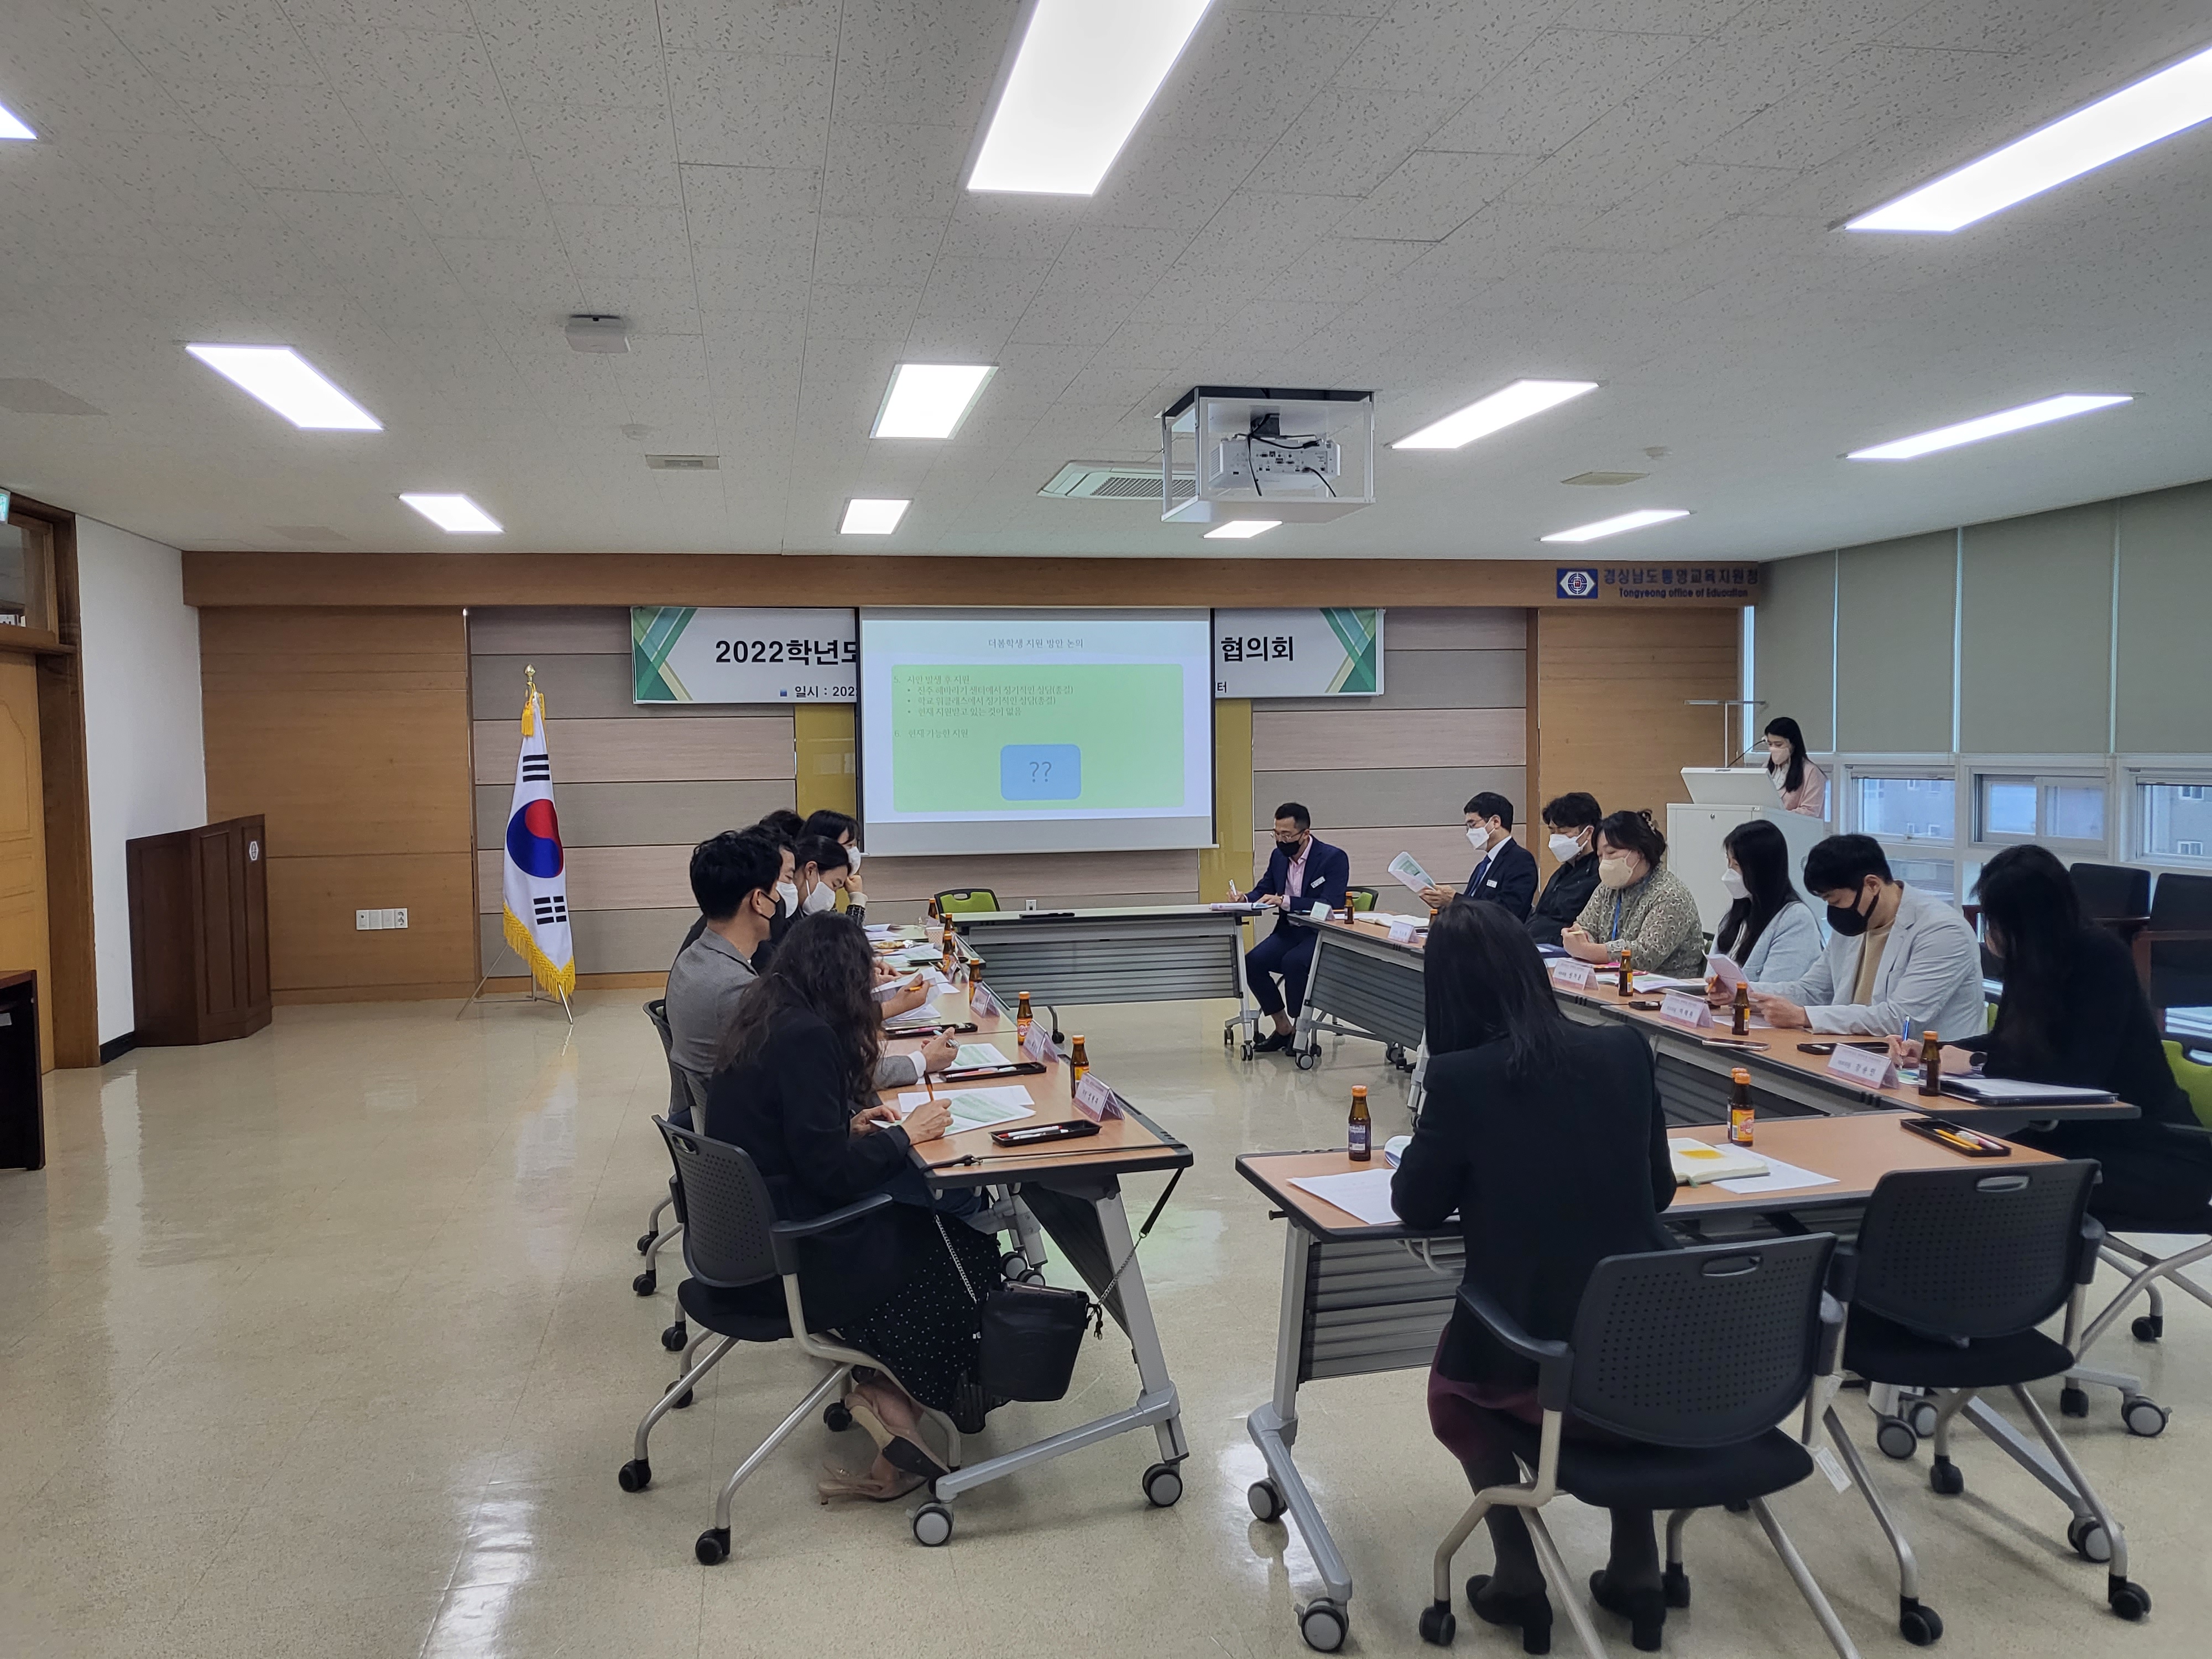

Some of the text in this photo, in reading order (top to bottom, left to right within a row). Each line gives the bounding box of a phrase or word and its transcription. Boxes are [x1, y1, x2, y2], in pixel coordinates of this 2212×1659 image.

[1619, 588, 1666, 598] Tongyeong
[1695, 588, 1704, 598] of
[1706, 588, 1748, 598] Education
[1026, 638, 1044, 649] 지원
[1067, 638, 1083, 649] 논의
[1220, 636, 1294, 662] 협의회
[794, 686, 819, 698] 일시
[832, 686, 857, 697] 202
[1217, 681, 1227, 693] 터
